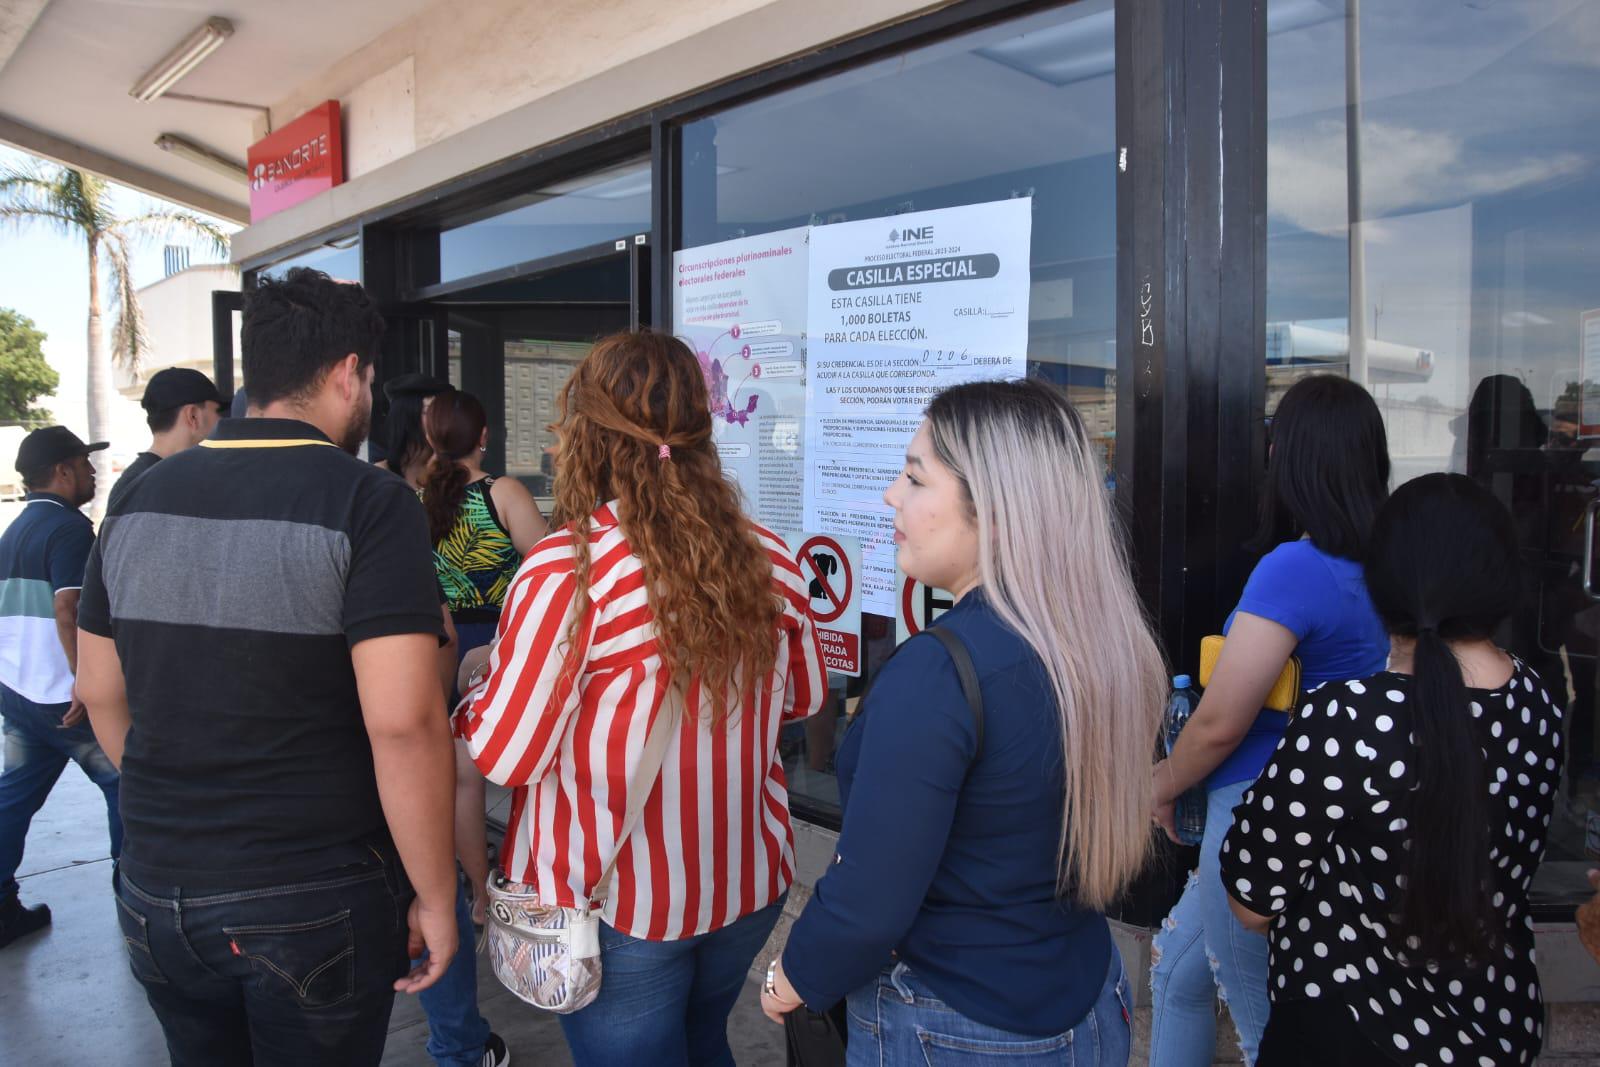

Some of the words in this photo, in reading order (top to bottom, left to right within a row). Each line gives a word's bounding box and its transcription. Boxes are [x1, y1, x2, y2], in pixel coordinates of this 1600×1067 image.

[267, 134, 327, 183] BANORTE
[902, 226, 934, 241] INE
[678, 256, 735, 273] Circunscripciones
[736, 246, 792, 265] plurinominales
[912, 249, 933, 257] FEDERAL
[678, 274, 713, 287] electorales
[714, 268, 746, 281] federales
[847, 266, 903, 286] CASILLA
[907, 259, 977, 280] ESPECIAL
[831, 298, 852, 309] ESTA
[855, 294, 893, 307] CASILLA
[895, 291, 922, 304] TIENE
[841, 313, 865, 327] 1,000
[867, 311, 911, 324] BOLETAS
[824, 332, 847, 344] PARA
[850, 330, 877, 342] CADA
[878, 326, 928, 341] ELECCIÓN.
[823, 360, 831, 369] SU
[831, 359, 866, 368] CREDENCIAL
[874, 358, 884, 367] DE
[884, 358, 892, 367] LA
[1002, 356, 1012, 365] DE
[875, 370, 888, 378] QUE
[853, 386, 892, 394] CIUDADANOS
[892, 397, 913, 405] VOTAR
[816, 630, 844, 643] HIBIDA
[820, 643, 848, 656] RADA
[825, 656, 854, 670] COTAS
